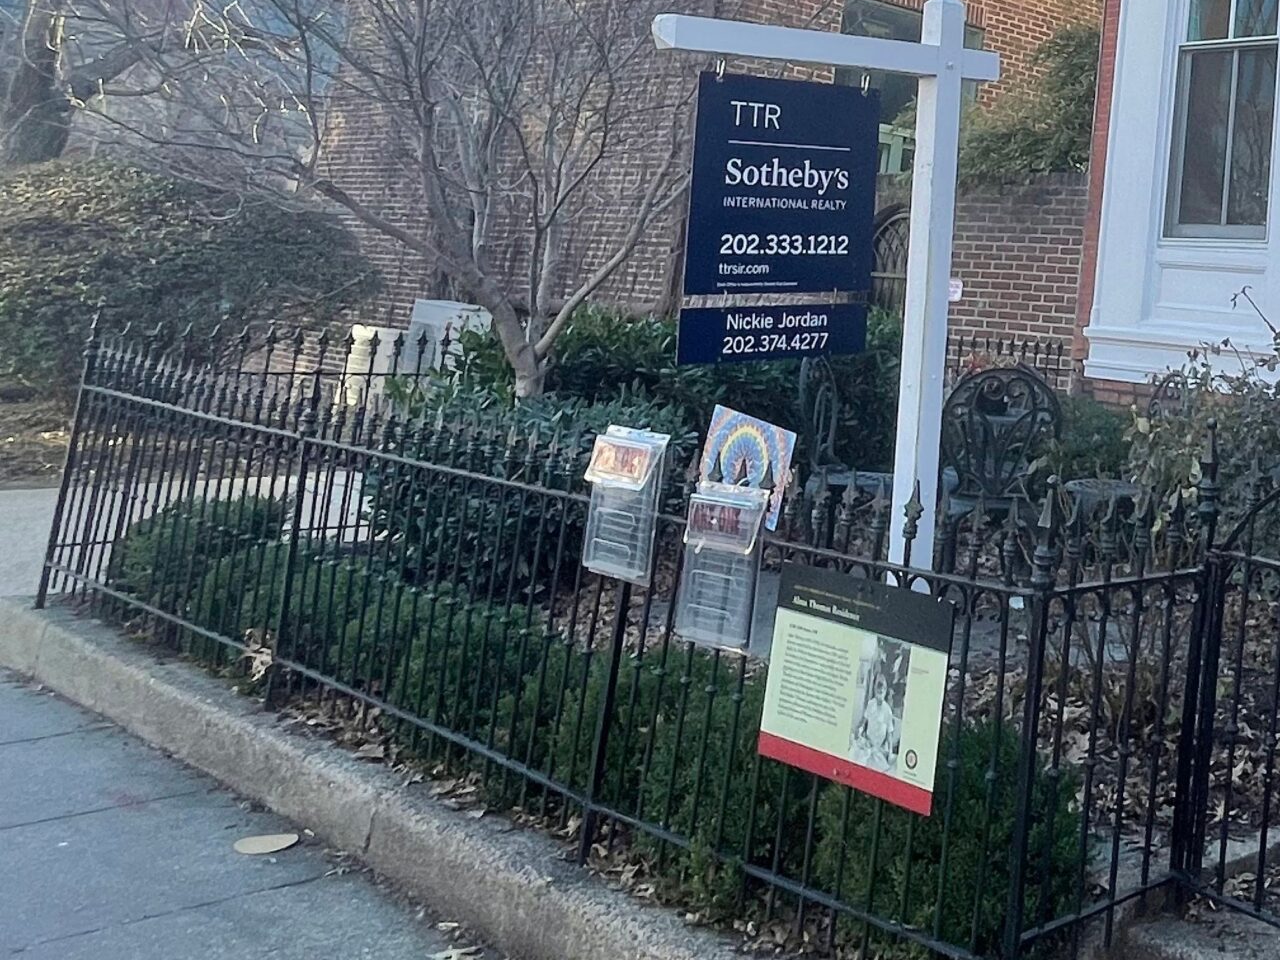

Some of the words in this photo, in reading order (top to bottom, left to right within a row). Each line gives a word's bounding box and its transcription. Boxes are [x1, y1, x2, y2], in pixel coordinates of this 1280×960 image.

[730, 100, 782, 130] TTR
[724, 157, 850, 196] Sotheby's
[723, 195, 810, 210] INTERNATIONAL
[810, 199, 847, 211] REALTY
[719, 233, 850, 255] 202.333.1212
[718, 262, 770, 275] ttrsir.com
[726, 312, 774, 331] Nickie
[777, 311, 828, 329] Jordan
[722, 332, 829, 355] 202.374.4277
